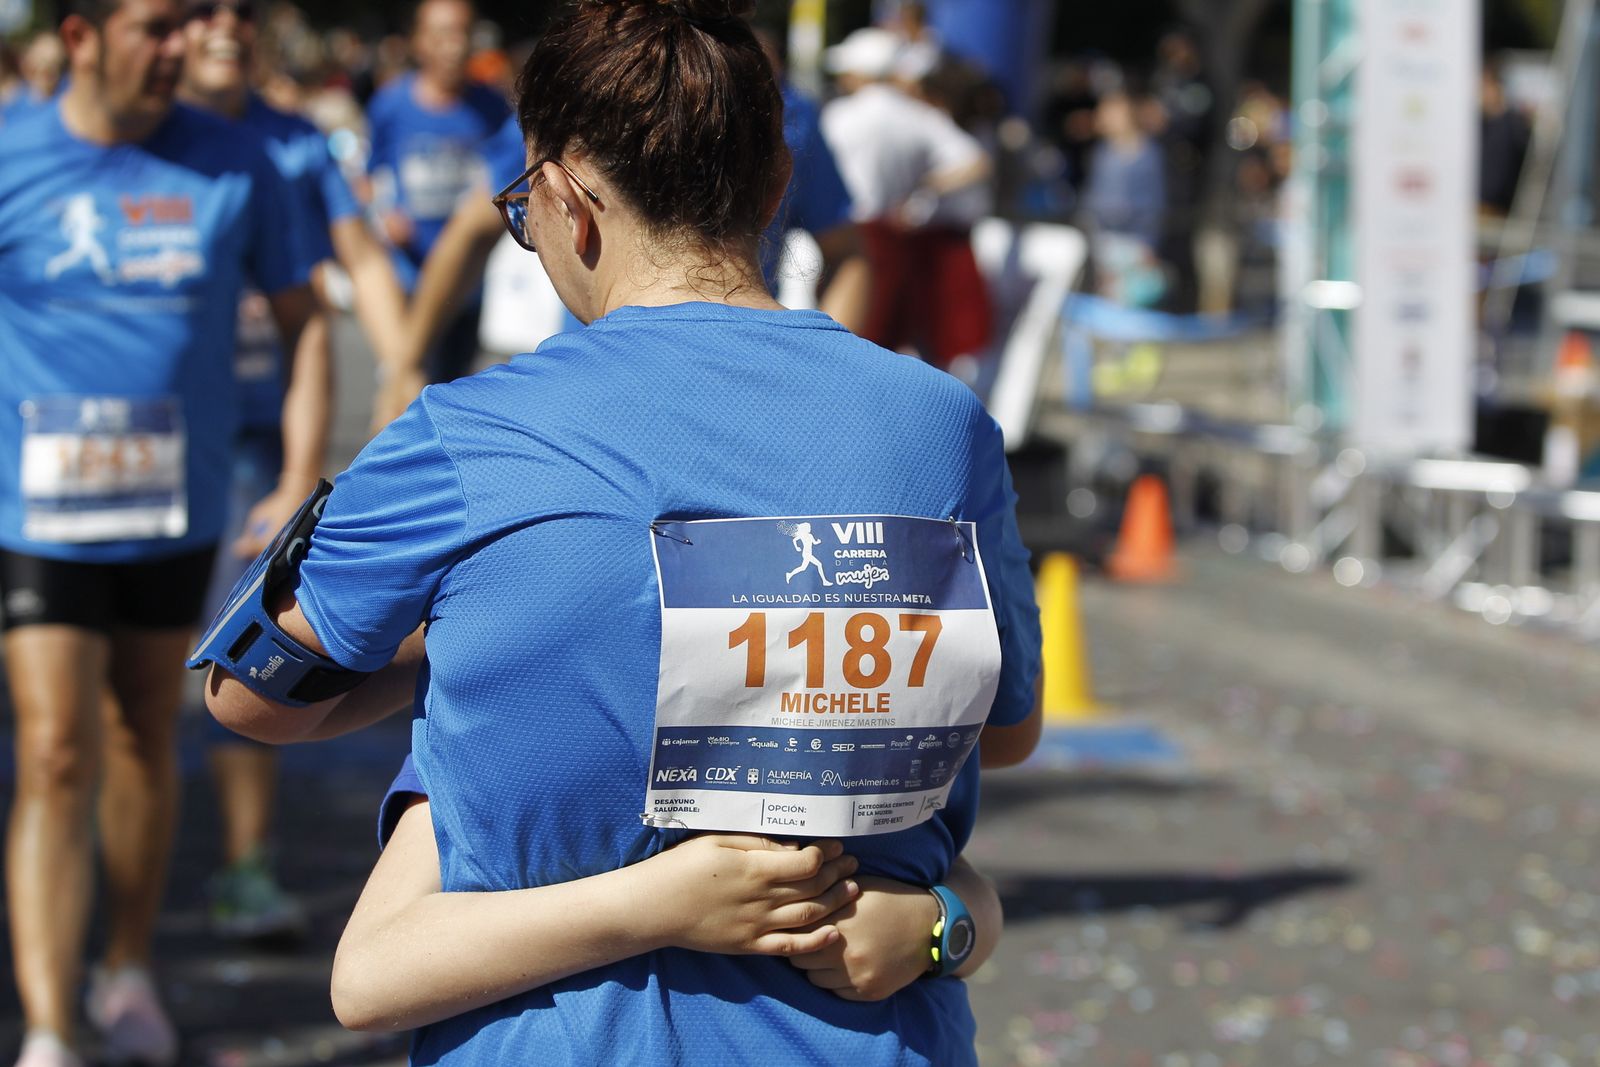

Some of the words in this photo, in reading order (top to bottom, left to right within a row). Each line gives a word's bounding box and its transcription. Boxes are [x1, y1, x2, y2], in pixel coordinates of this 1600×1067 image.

[831, 521, 884, 544] VIII
[834, 549, 888, 559] CARRERA
[835, 559, 855, 567] DE
[871, 559, 888, 567] LA
[731, 594, 749, 604] LA
[752, 594, 821, 604] IGUALDAD
[825, 593, 840, 603] ES
[844, 593, 901, 603] NUESTRA
[902, 594, 932, 604] META
[728, 611, 944, 689] 1187
[258, 654, 285, 681] aqualia
[780, 692, 891, 714] MICHELE
[771, 717, 814, 727] MICHELE
[816, 719, 856, 728] JIMENEZ
[857, 718, 896, 727] MARTINS
[672, 738, 700, 747] cajamar
[751, 740, 779, 749] aqualia
[831, 743, 856, 752] SER
[656, 767, 698, 782] NEXA
[705, 766, 741, 782] CDX
[767, 770, 813, 780] ALMERÍA
[767, 803, 807, 814] OPCIÓN:
[766, 817, 798, 825] TALLA:
